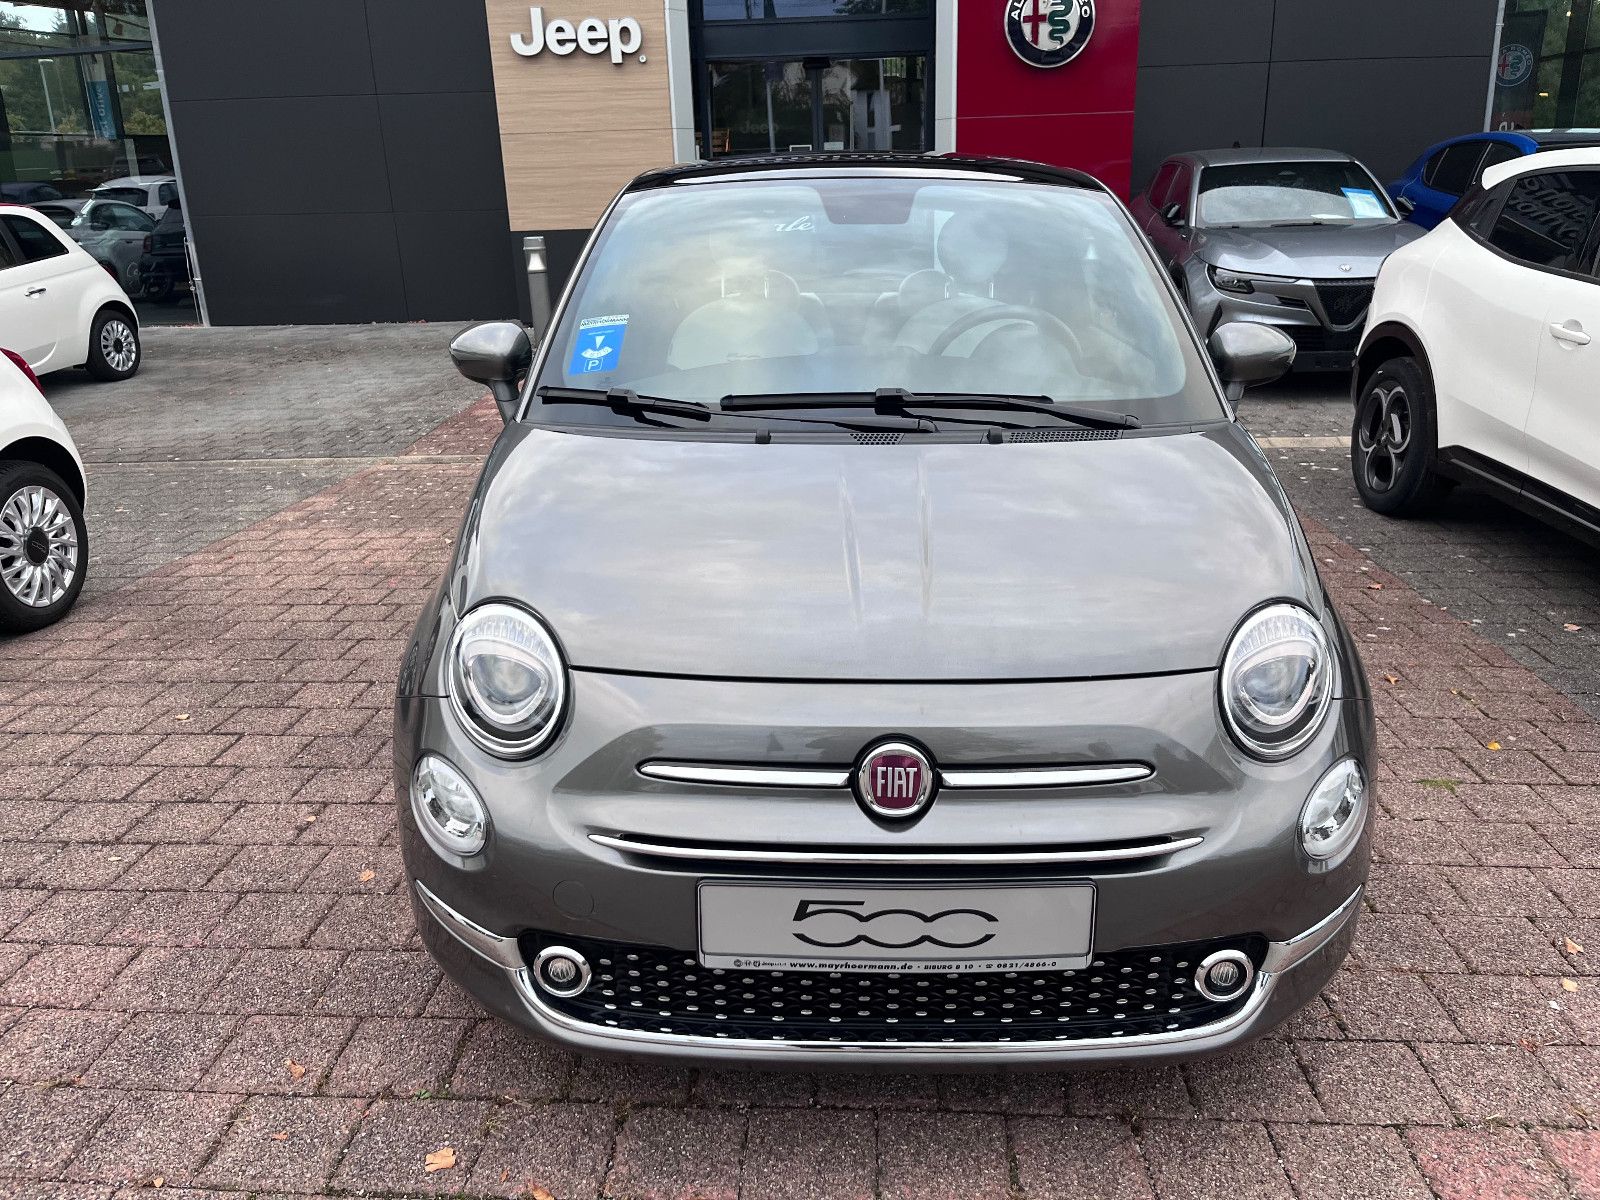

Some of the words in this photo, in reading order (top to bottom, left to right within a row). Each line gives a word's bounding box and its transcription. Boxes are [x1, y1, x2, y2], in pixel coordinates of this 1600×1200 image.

[510, 6, 642, 64] Jeep
[876, 766, 918, 798] FIAT
[792, 900, 999, 948] 500
[789, 961, 913, 971] www.mayrhoermann.de
[996, 961, 1057, 969] 0821/4866-0
